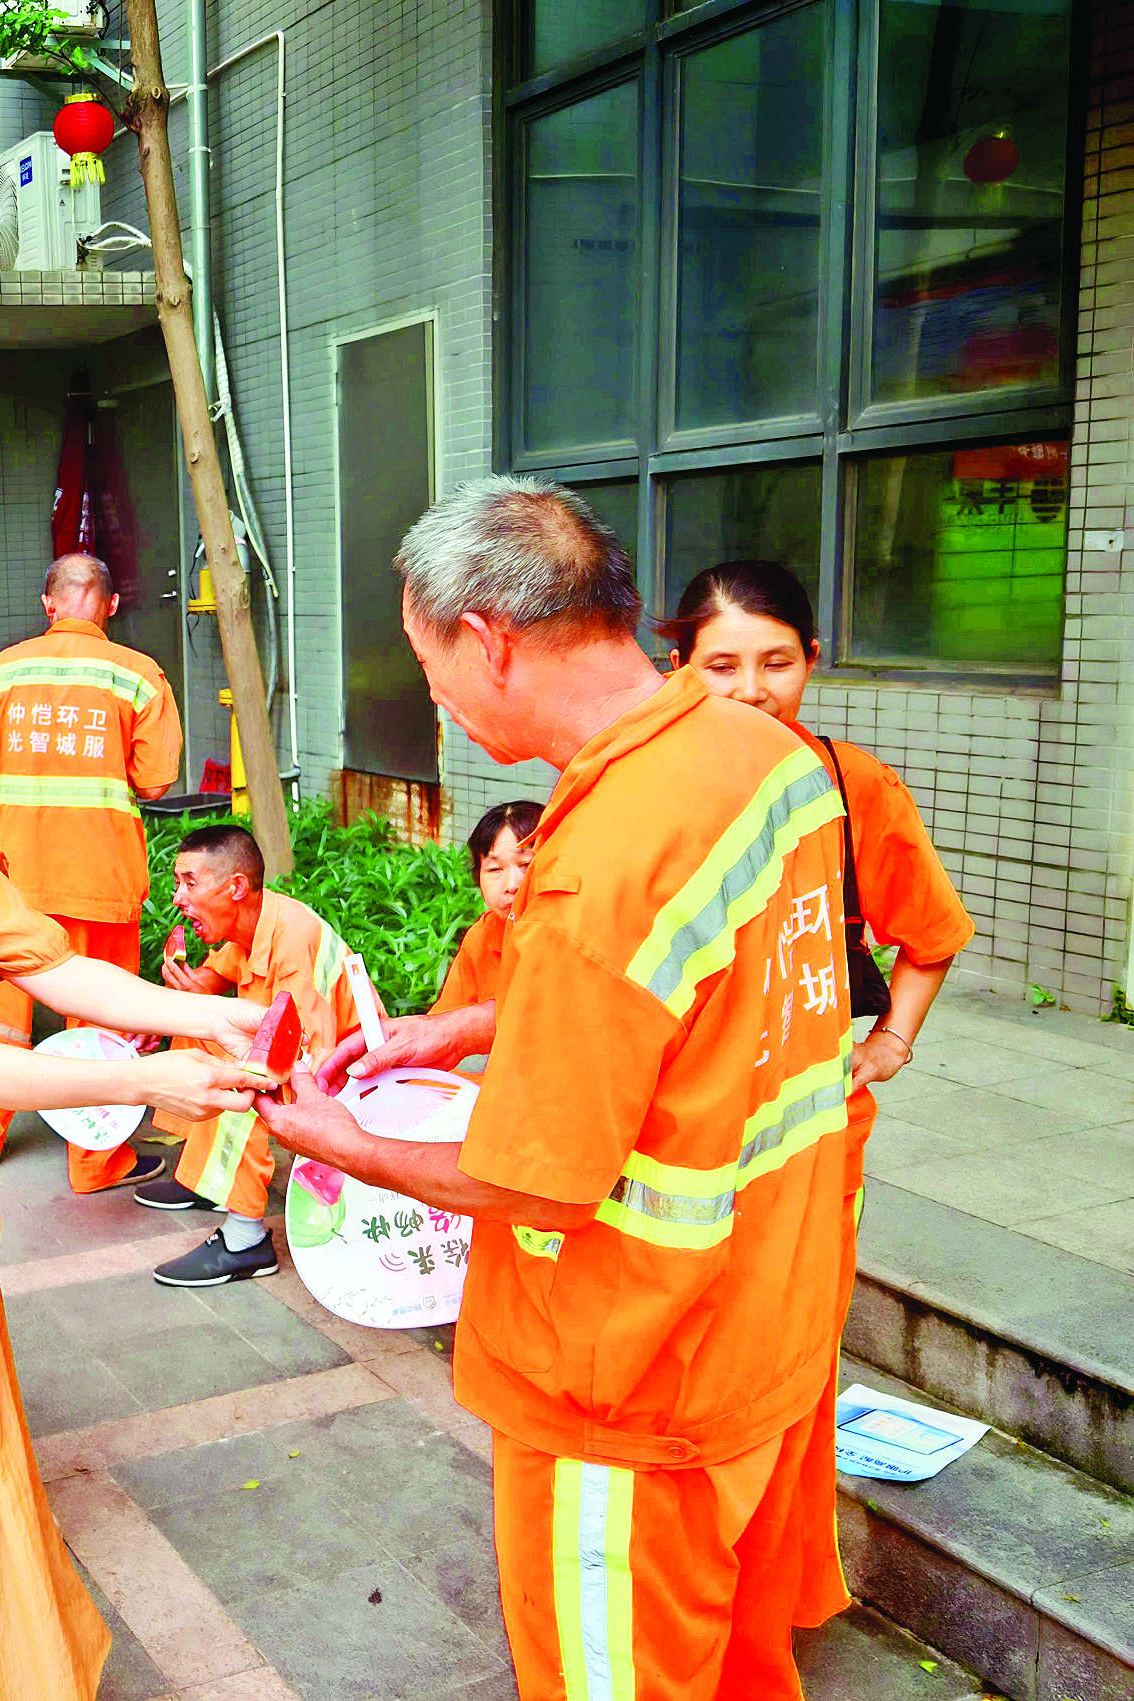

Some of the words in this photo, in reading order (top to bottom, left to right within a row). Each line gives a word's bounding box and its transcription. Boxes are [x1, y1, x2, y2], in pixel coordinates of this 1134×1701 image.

[8, 702, 107, 731] 仲恺环卫
[8, 730, 105, 759] 光智城服
